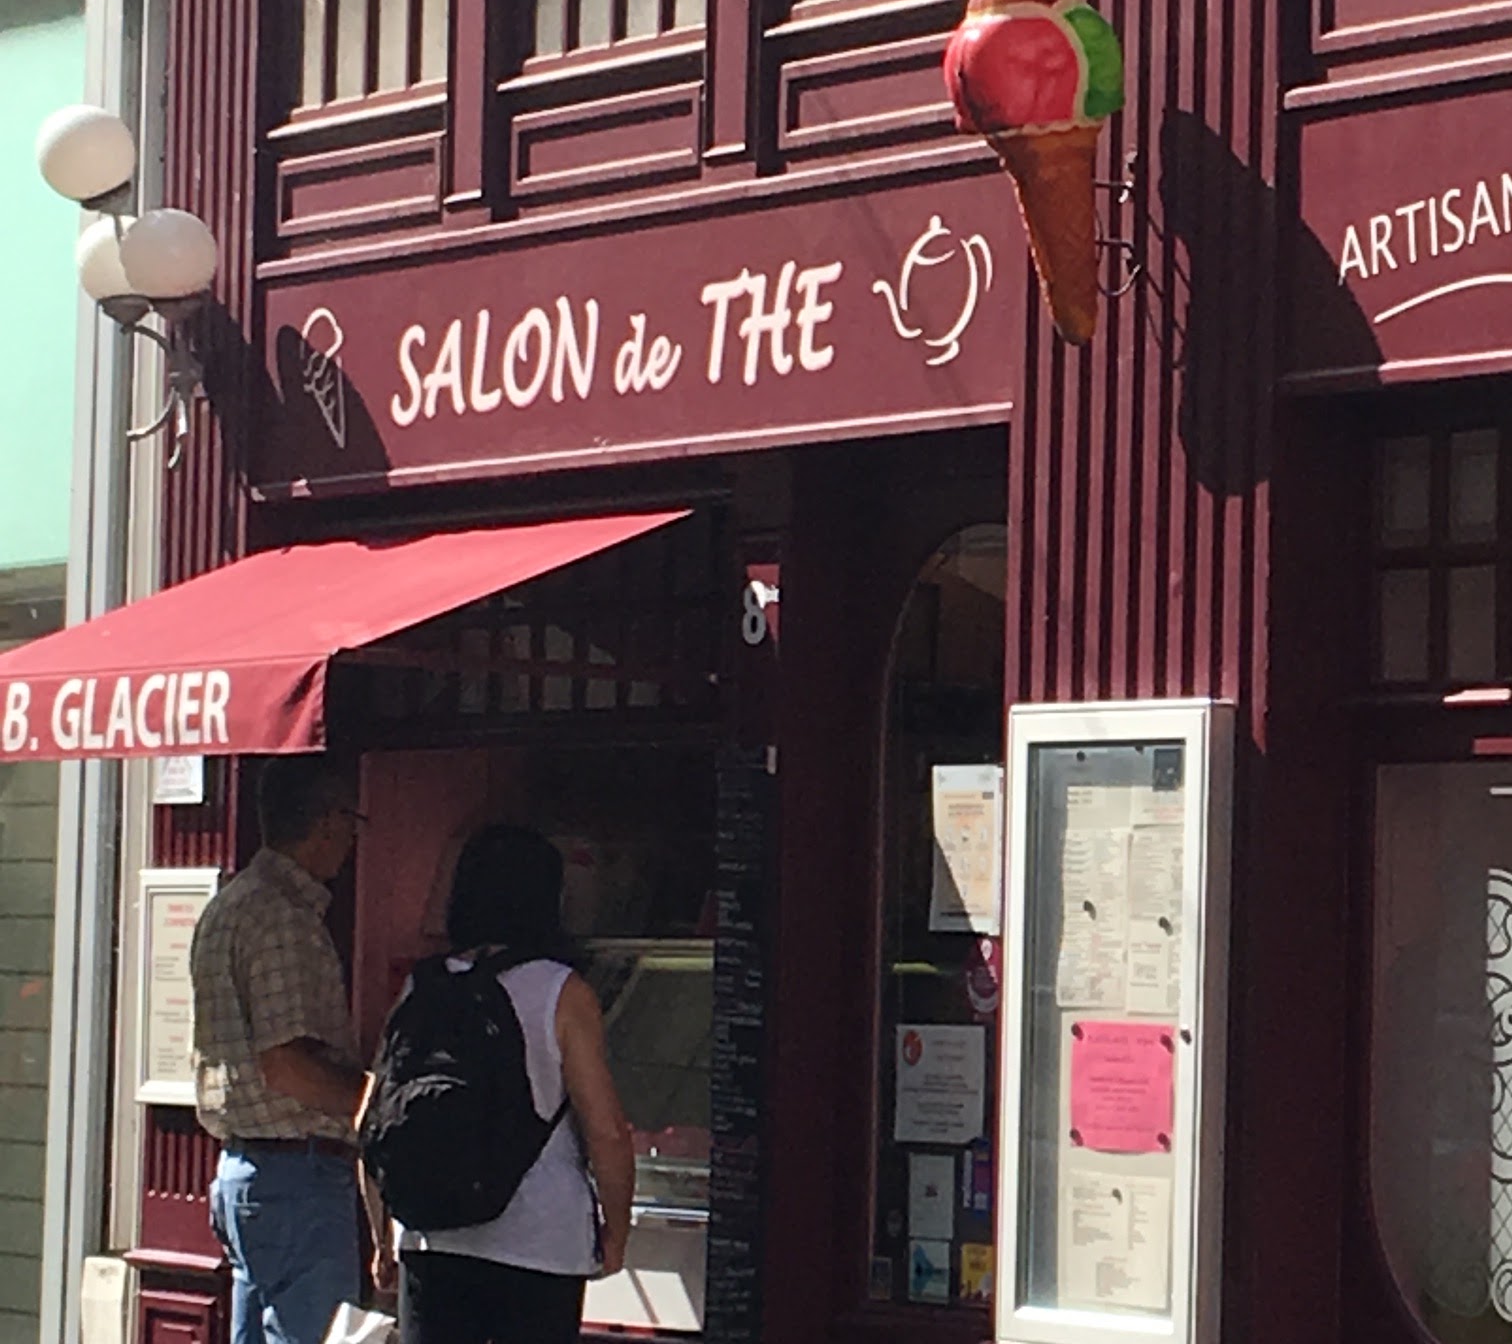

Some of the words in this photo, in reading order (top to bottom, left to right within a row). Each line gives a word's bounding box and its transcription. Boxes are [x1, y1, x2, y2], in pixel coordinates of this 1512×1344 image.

[390, 294, 600, 427] SALON
[613, 312, 683, 396] de
[701, 259, 843, 387] THE
[742, 579, 766, 645] 8
[1, 680, 39, 753] B.
[51, 668, 231, 751] GLACIER
